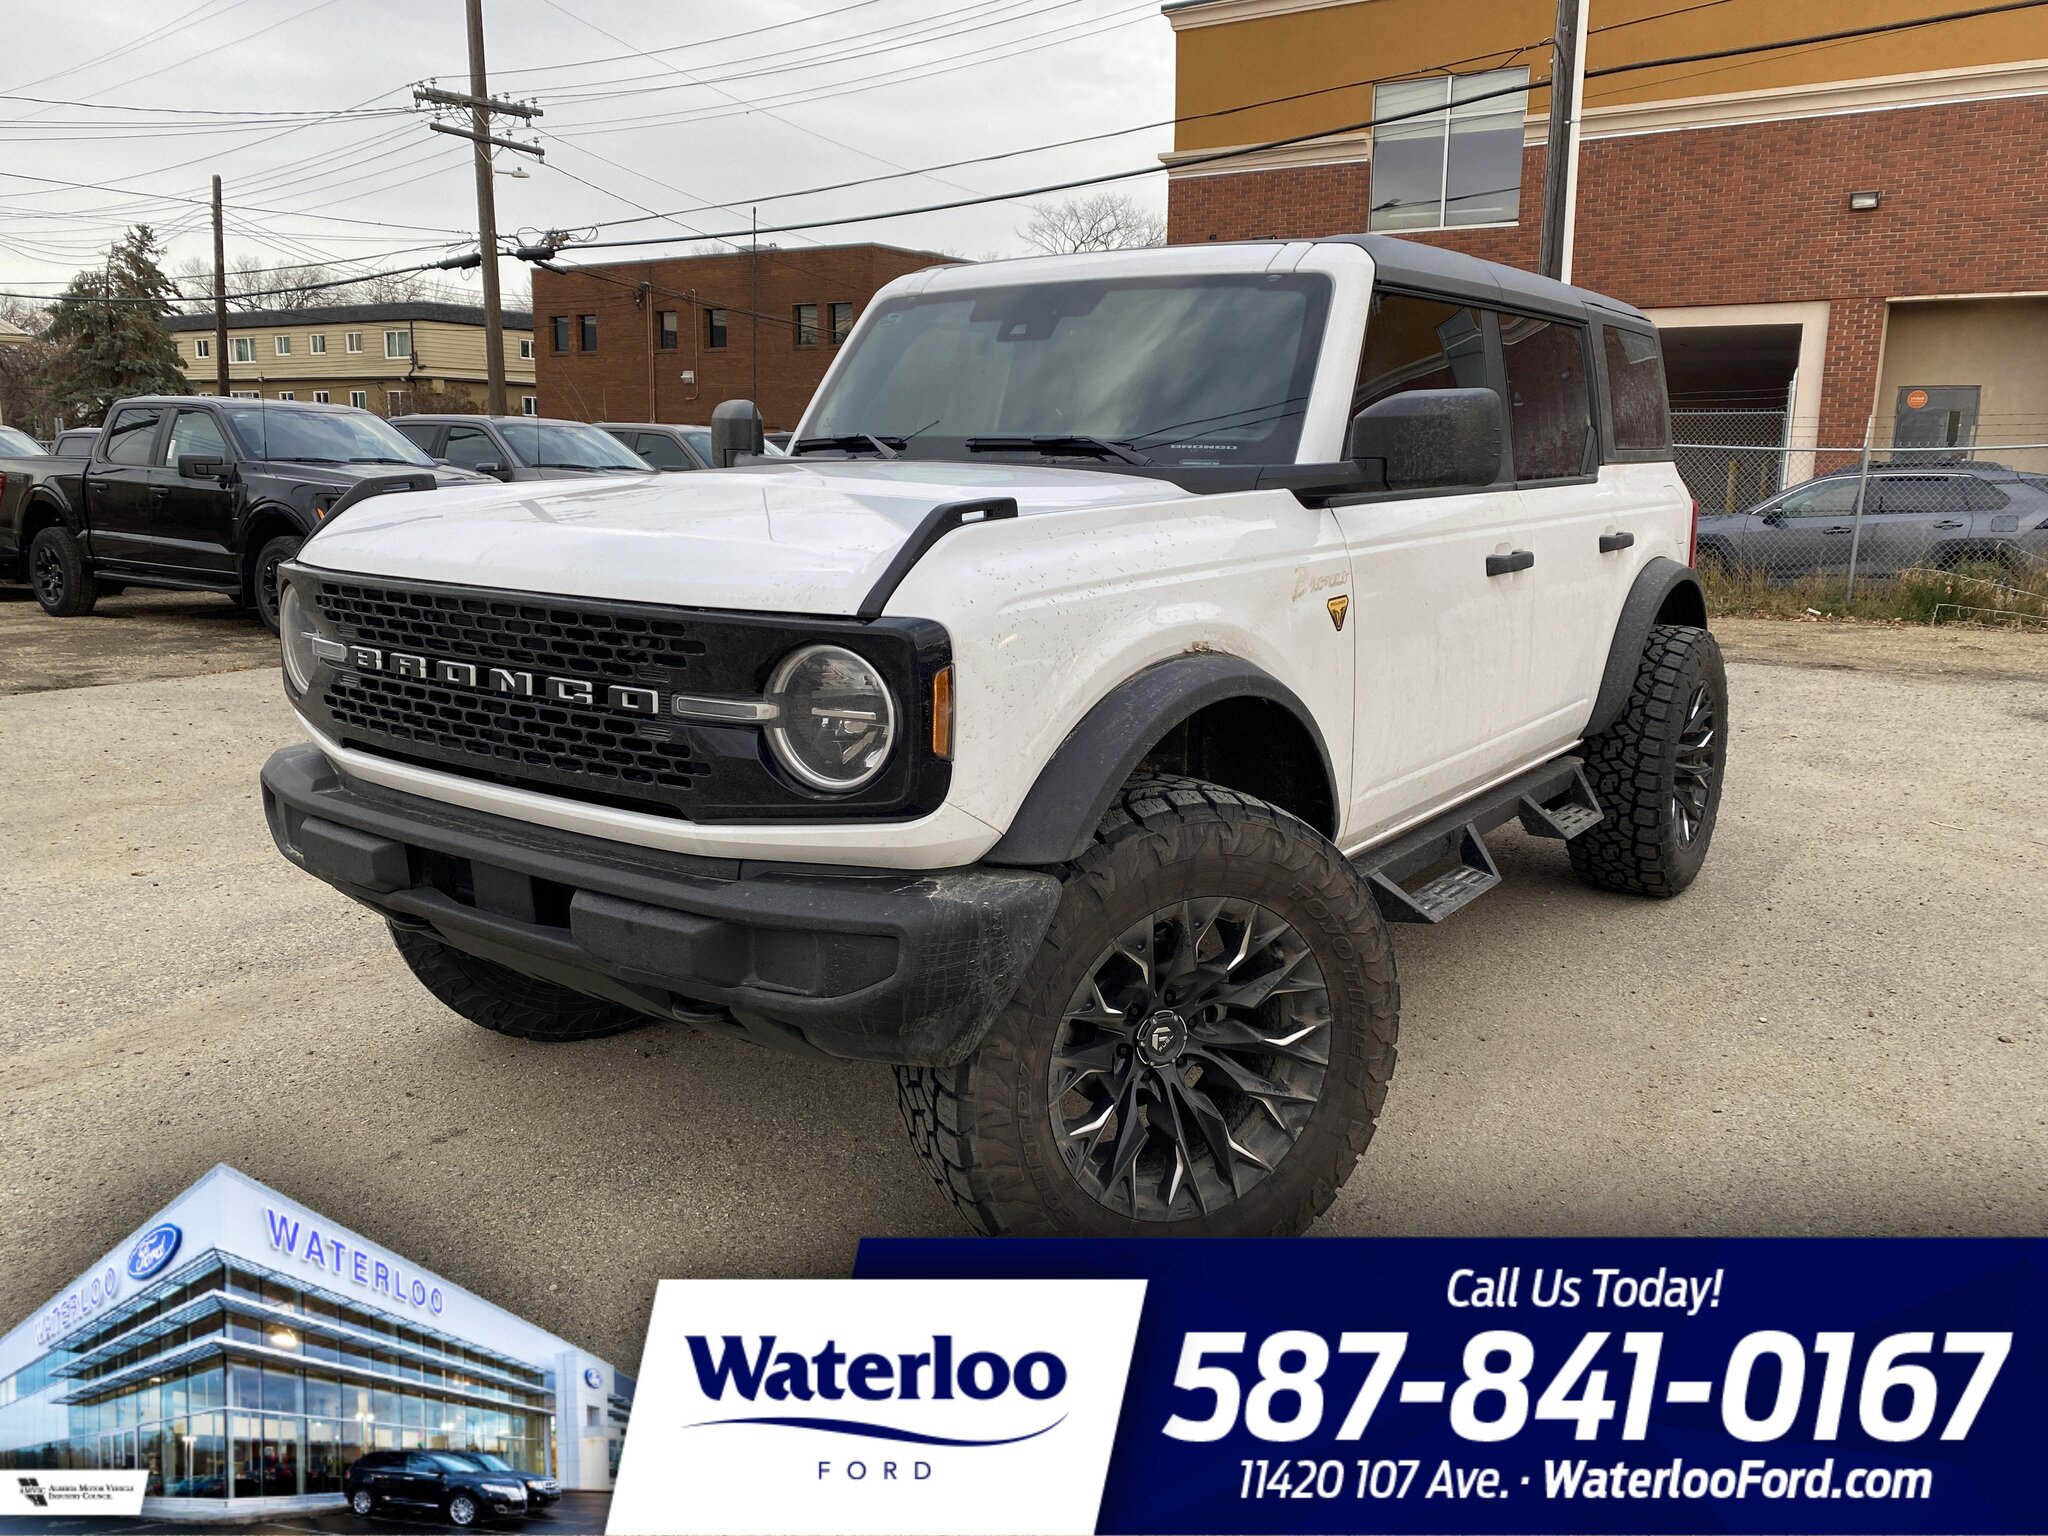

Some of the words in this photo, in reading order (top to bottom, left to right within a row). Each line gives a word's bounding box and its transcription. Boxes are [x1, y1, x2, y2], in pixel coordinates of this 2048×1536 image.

[1292, 566, 1350, 602] Bronco
[346, 645, 660, 715] BRONCO
[1287, 876, 1354, 961] TOYO
[1158, 1034, 1174, 1053] FUEL
